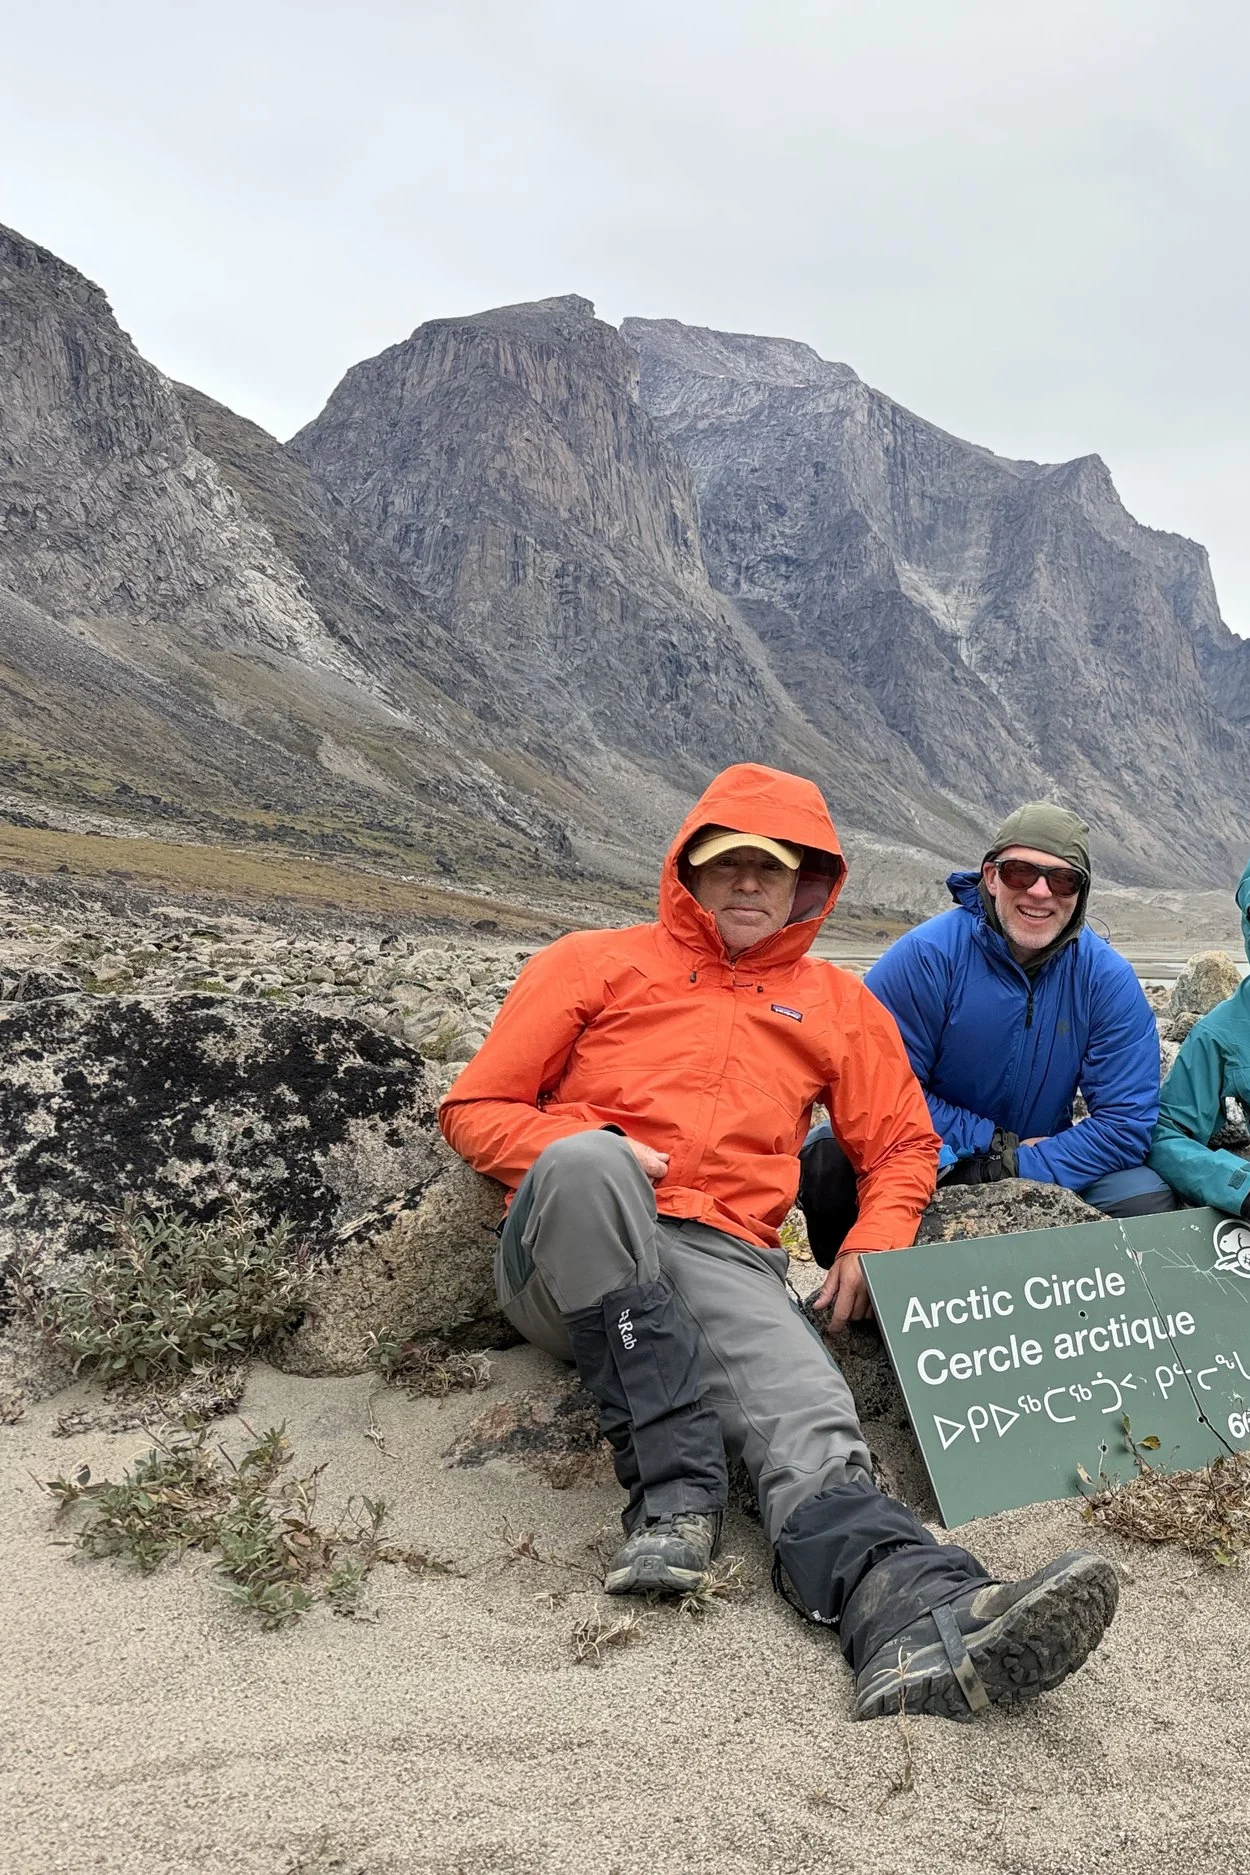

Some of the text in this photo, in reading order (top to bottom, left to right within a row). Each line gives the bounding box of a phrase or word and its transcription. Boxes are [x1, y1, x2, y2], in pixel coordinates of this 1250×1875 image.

[902, 1267, 1126, 1333] Arctic Circle
[617, 1320, 638, 1350] Rab
[917, 1310, 1196, 1385] Cercle arctique
